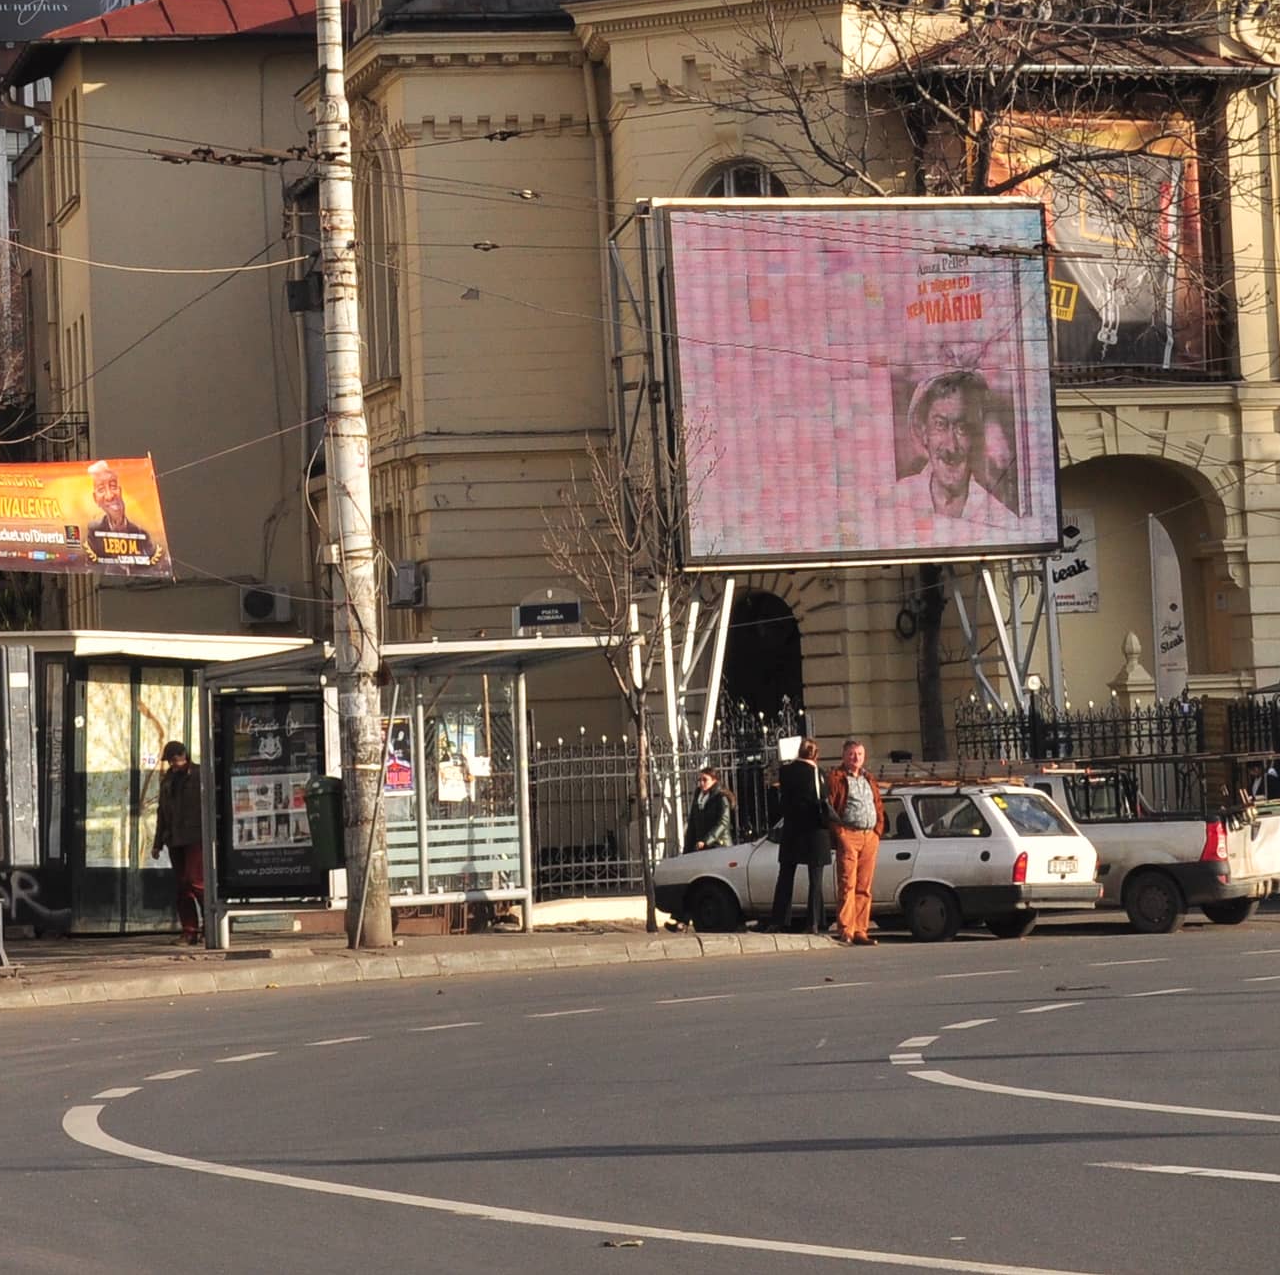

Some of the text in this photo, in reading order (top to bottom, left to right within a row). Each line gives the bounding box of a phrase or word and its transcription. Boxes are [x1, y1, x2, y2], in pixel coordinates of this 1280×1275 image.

[926, 292, 982, 324] MĂRIN
[103, 537, 141, 554] LEBO M.
[1052, 558, 1090, 583] teak
[1160, 634, 1185, 654] Steak
